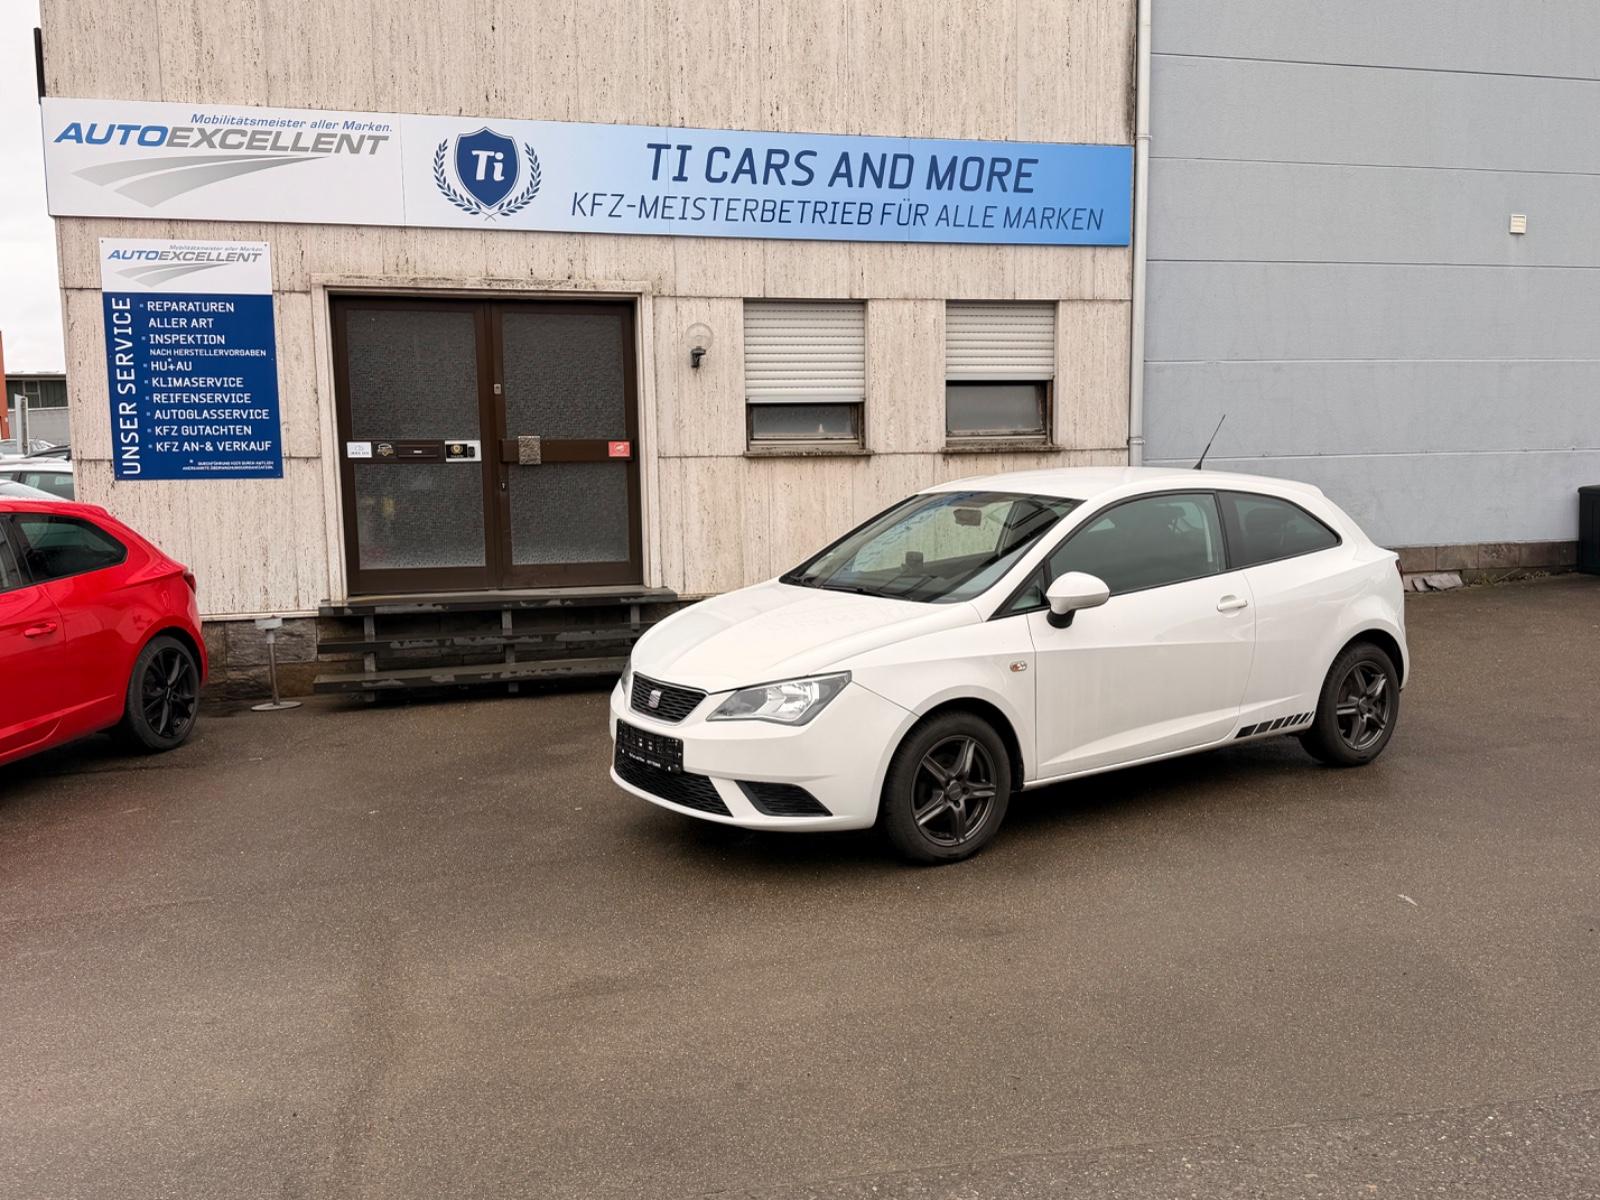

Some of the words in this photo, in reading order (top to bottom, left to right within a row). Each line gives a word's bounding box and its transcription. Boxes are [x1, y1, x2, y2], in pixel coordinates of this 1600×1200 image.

[310, 119, 339, 130] aller
[342, 120, 393, 132] Marken.
[54, 122, 390, 155] AUTOEXCELLENT
[471, 149, 505, 182] Ti
[646, 143, 693, 182] TI
[704, 146, 818, 186] CARS
[827, 151, 915, 190] AND
[925, 154, 1040, 193] MORE
[571, 191, 874, 226] KFZ-MEISTERBETRIEB
[879, 198, 930, 227] FÜR
[934, 203, 999, 229] ALLE
[1002, 205, 1105, 231] MARKEN
[107, 249, 263, 263] AUTOEXCELLENT
[147, 301, 235, 313] REPARATUREN
[148, 317, 188, 329] ALLER
[190, 318, 215, 329] ART
[149, 334, 226, 345] INSPEKTION
[111, 297, 136, 396] SERVICE
[149, 348, 173, 357] NACH
[173, 348, 267, 357] HERSTELLERVORGABEN
[151, 377, 244, 388] KLIMASERVICE
[153, 393, 252, 404] REIFENSERVICE
[154, 409, 270, 420] AUTOGLASSERVICE
[155, 425, 179, 436] KFZ
[181, 425, 252, 436] GUTACHTEN
[118, 401, 141, 475] UNSER
[156, 441, 180, 452] KFZ
[216, 441, 273, 452] VERKAUF
